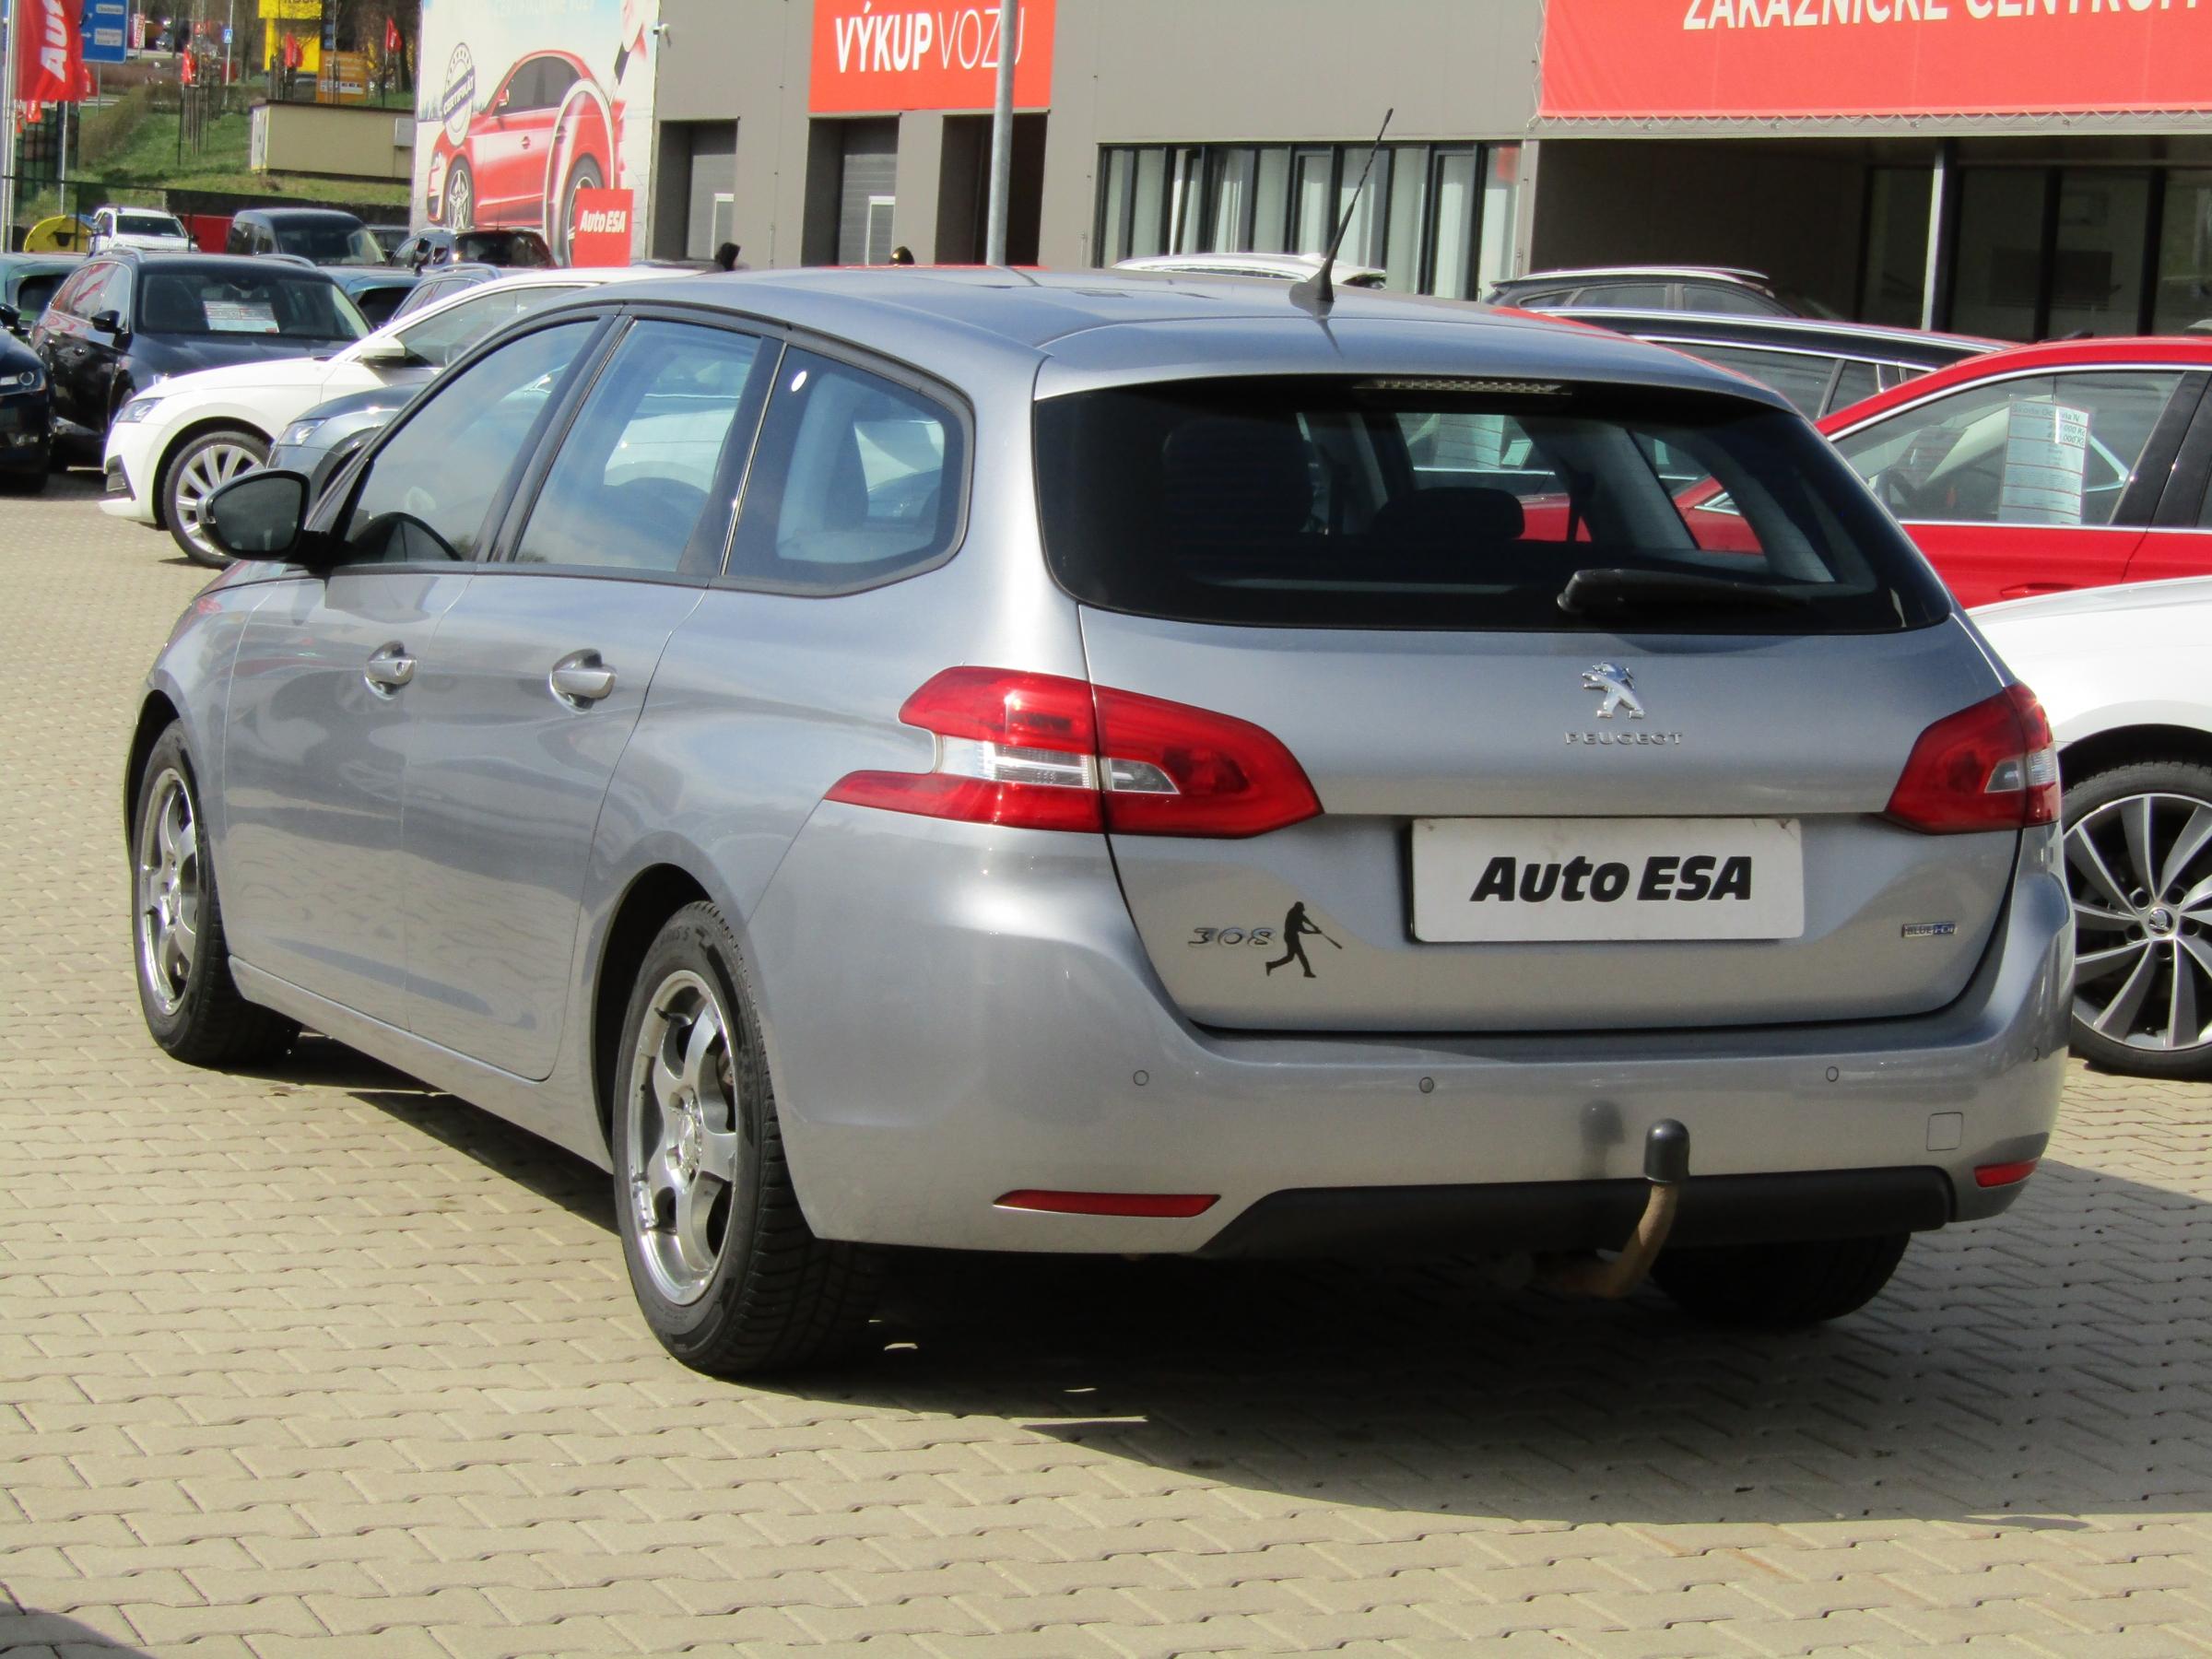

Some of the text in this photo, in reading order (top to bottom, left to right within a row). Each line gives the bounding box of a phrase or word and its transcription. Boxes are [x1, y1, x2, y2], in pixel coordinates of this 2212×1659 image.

[835, 1, 933, 73] VÝKUP
[579, 210, 627, 233] Auto ESA
[1565, 732, 1683, 745] PEUGEOT
[1470, 855, 1751, 902] Auto ESA
[1188, 927, 1277, 947] 308
